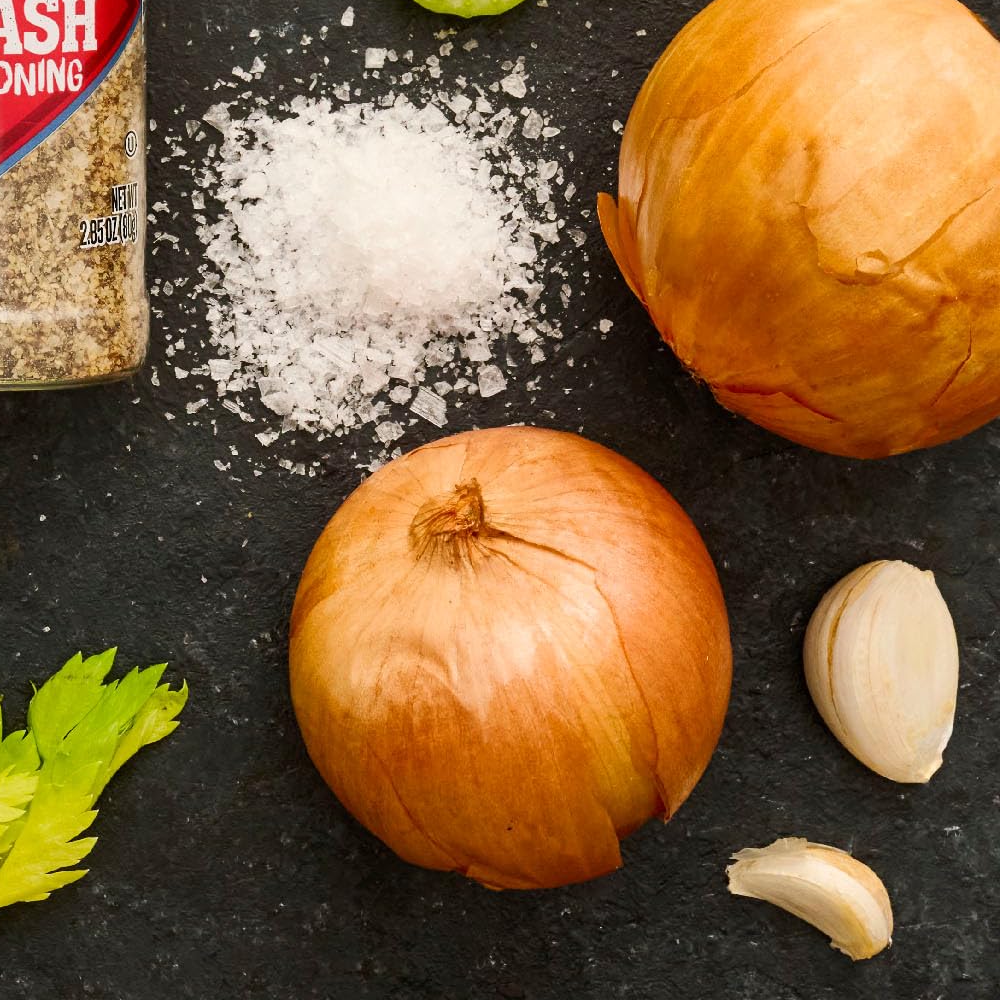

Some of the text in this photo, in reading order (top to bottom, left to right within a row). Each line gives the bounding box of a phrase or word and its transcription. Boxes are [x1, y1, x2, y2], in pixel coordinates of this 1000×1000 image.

[112, 185, 127, 213] NET
[80, 218, 104, 246] 2.85
[105, 216, 118, 243] OZ
